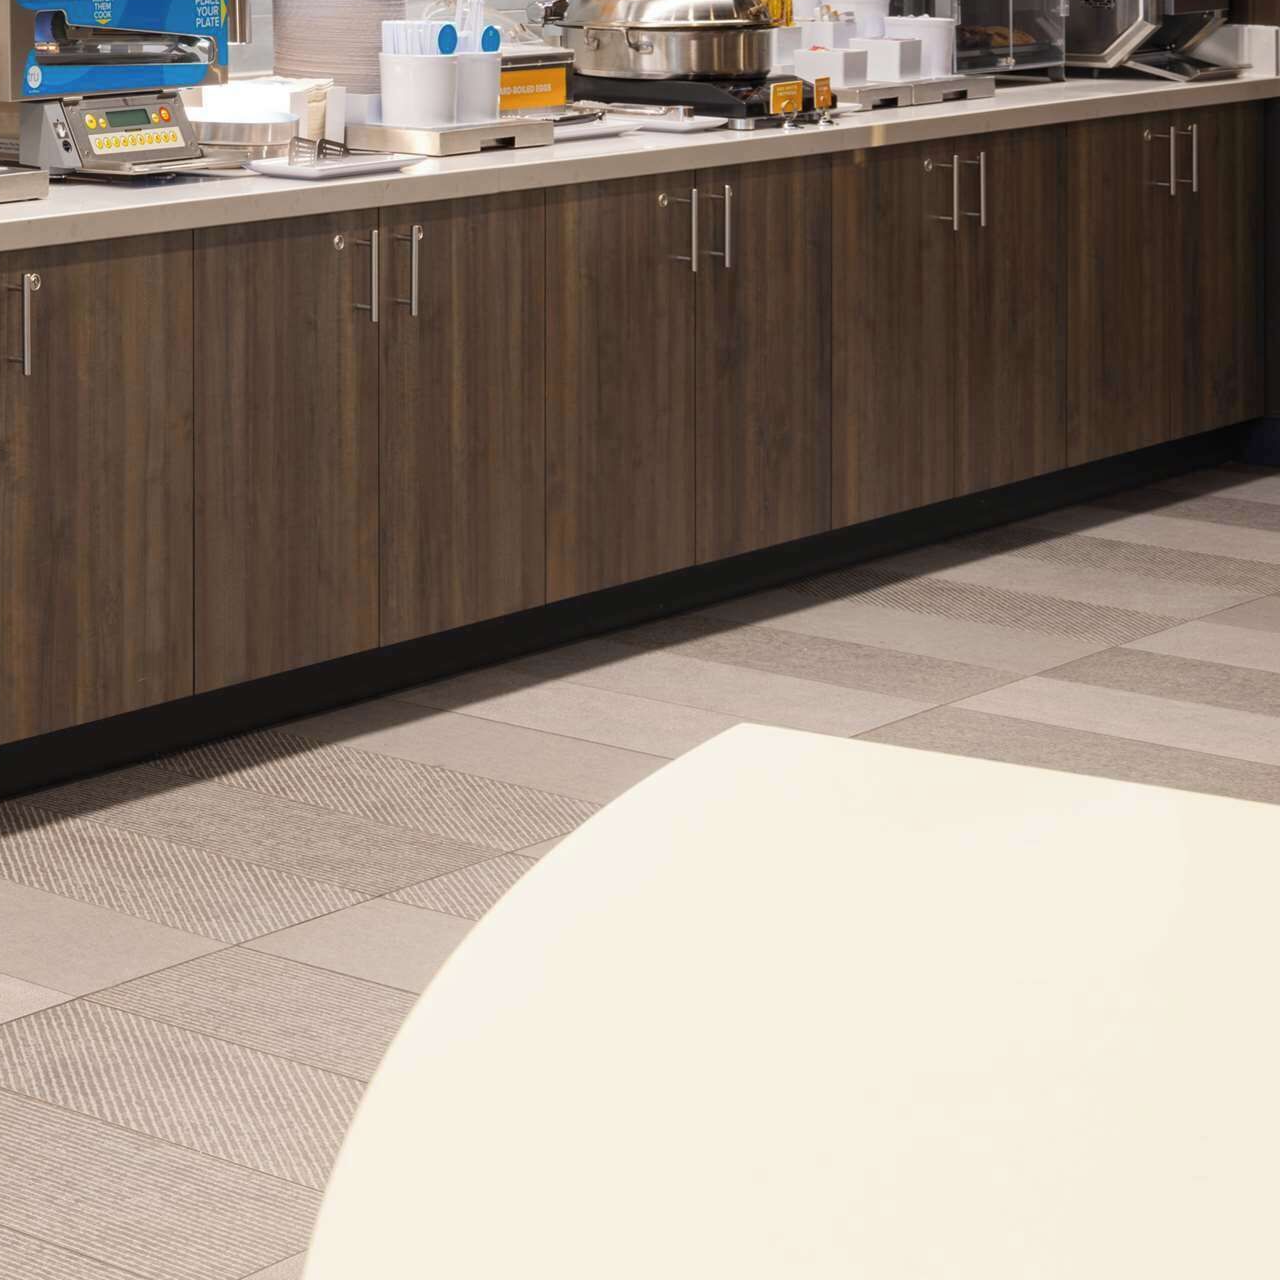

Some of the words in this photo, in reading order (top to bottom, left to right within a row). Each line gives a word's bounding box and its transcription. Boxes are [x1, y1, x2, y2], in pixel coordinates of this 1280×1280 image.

[94, 2, 112, 11] THEM
[196, 6, 219, 17] YOUR
[93, 11, 112, 19] COOK
[196, 17, 220, 29] PLATE
